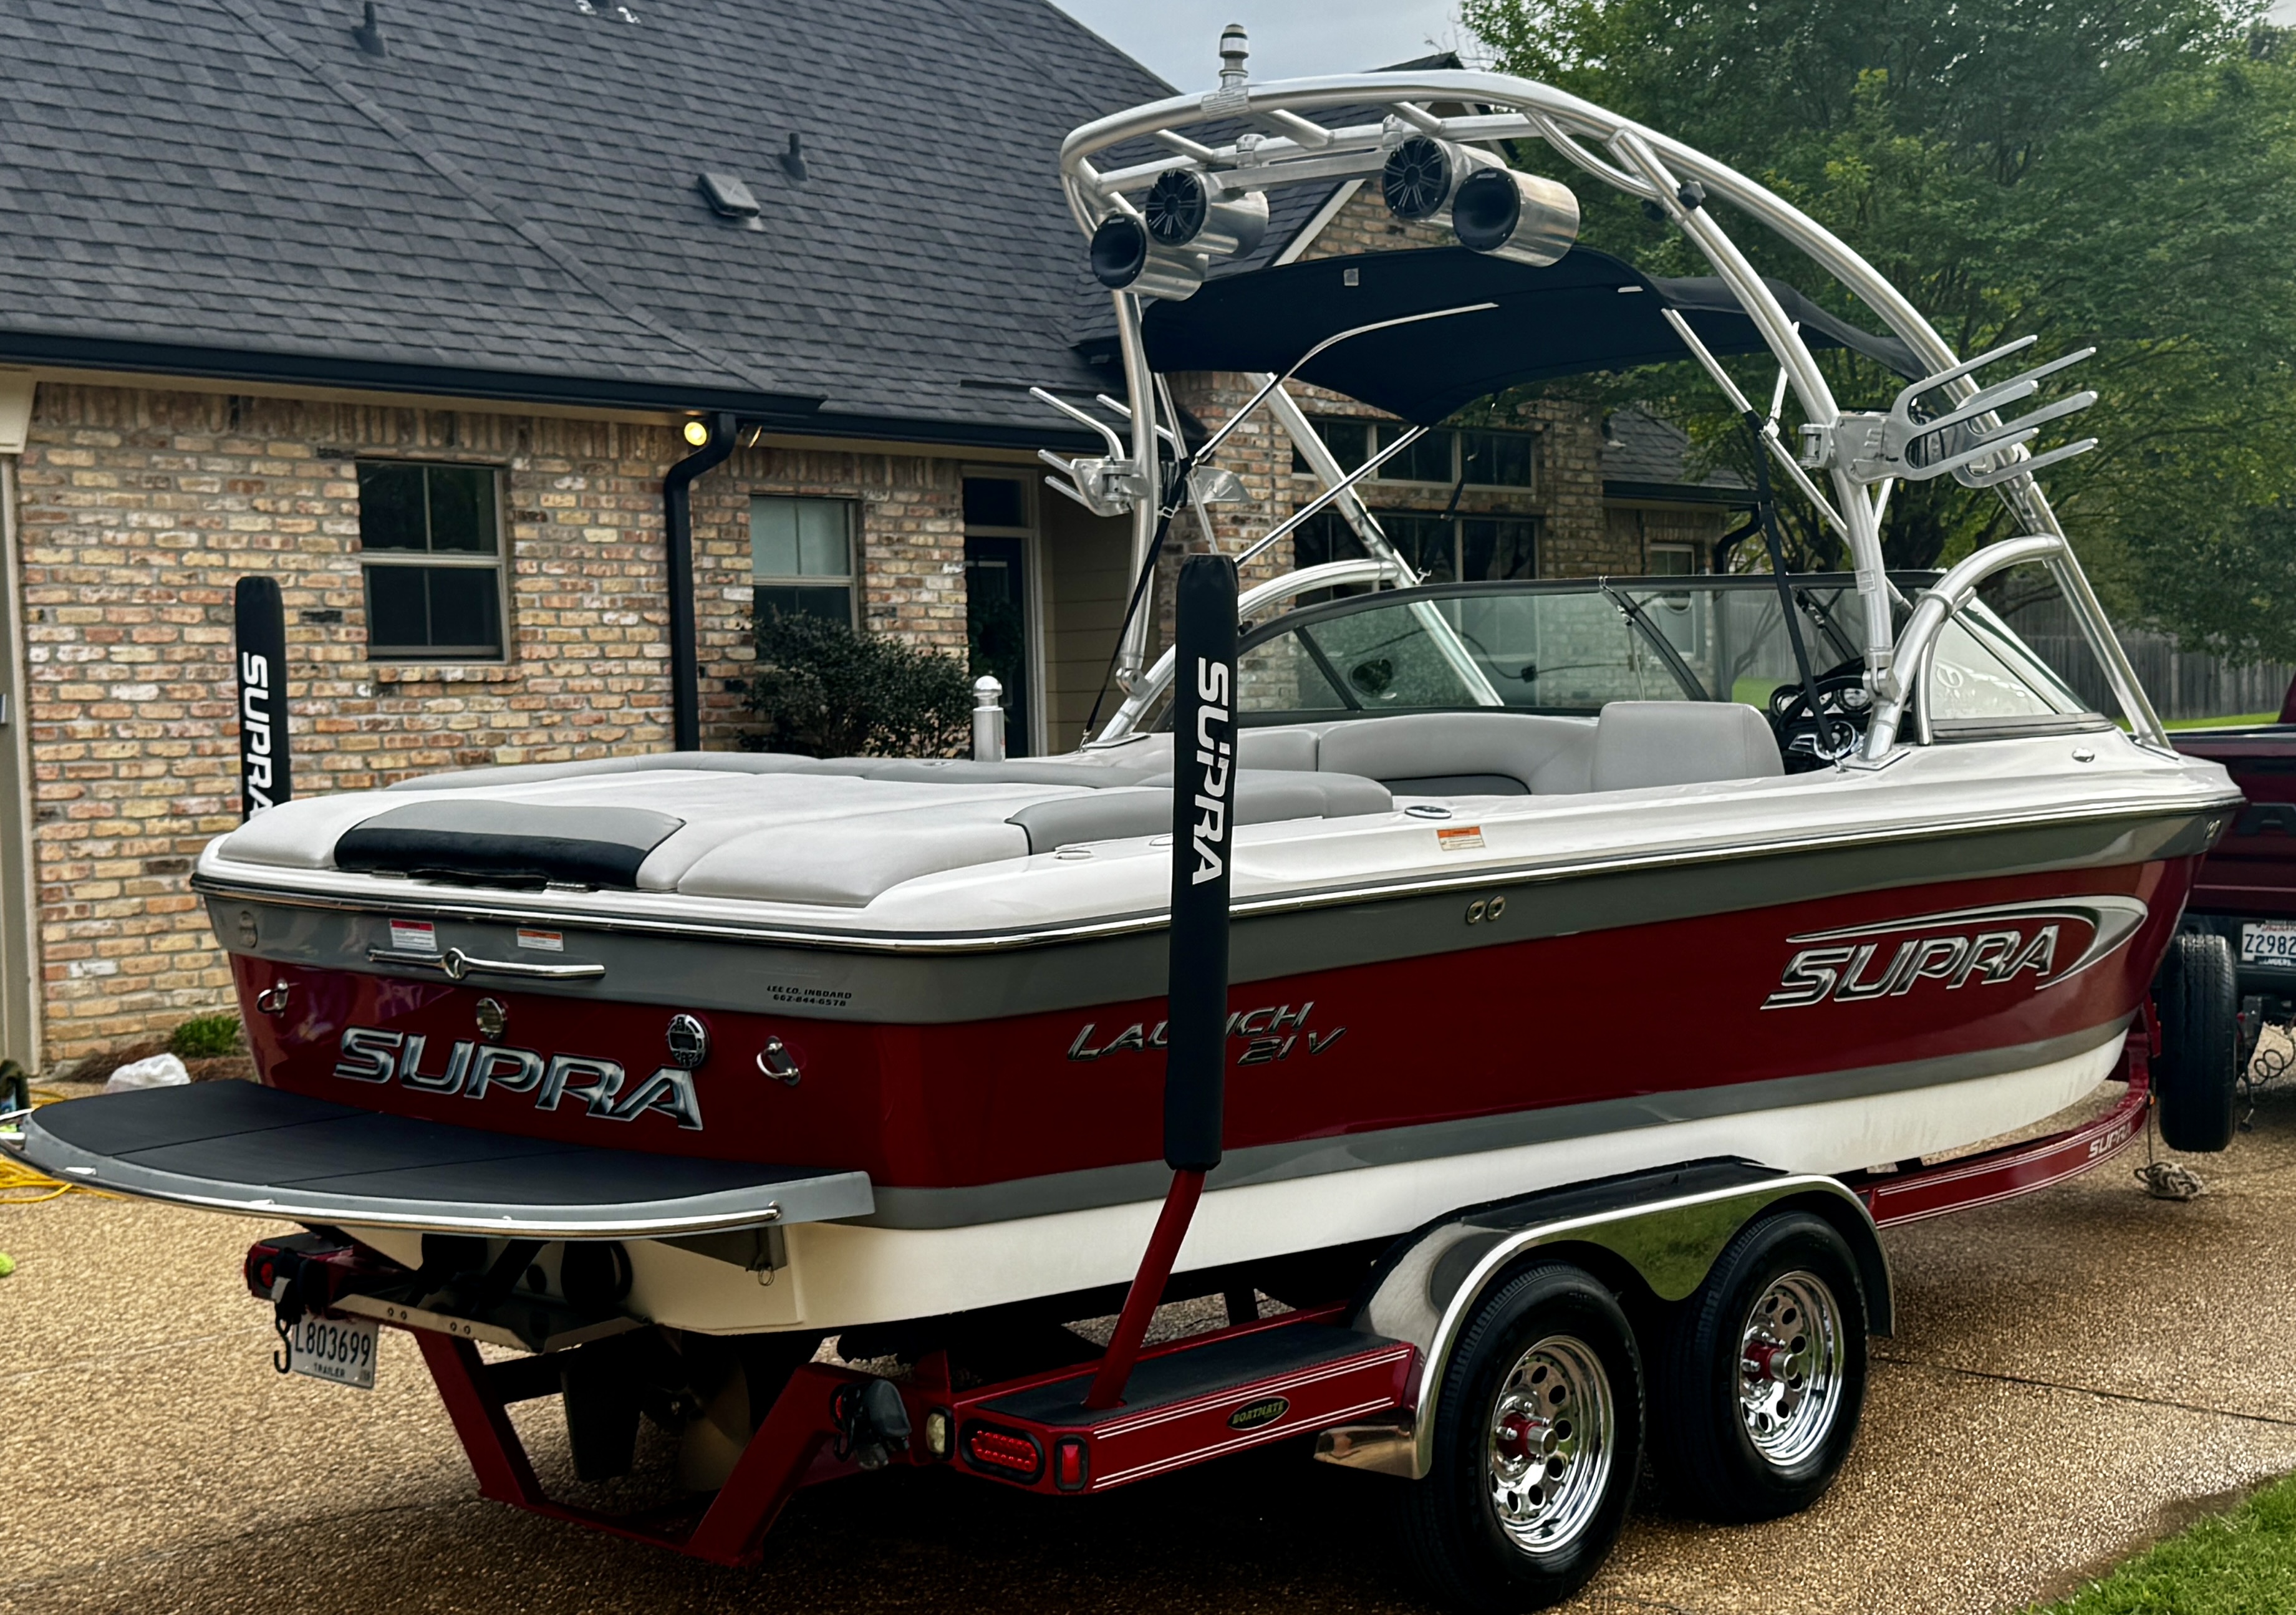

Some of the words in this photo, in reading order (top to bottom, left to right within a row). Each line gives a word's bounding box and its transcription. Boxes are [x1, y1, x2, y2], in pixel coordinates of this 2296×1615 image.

[242, 652, 273, 819] SUPRA
[1192, 657, 1230, 885] SUPRA
[1760, 924, 2060, 1010] SUPRA
[2244, 933, 2296, 956] Z2982
[804, 989, 852, 999] INBOARD
[332, 1025, 704, 1131] SUPRA
[2086, 1119, 2131, 1159] SUPRA
[295, 1321, 371, 1367] L803699
[314, 1362, 345, 1378] TRAILER
